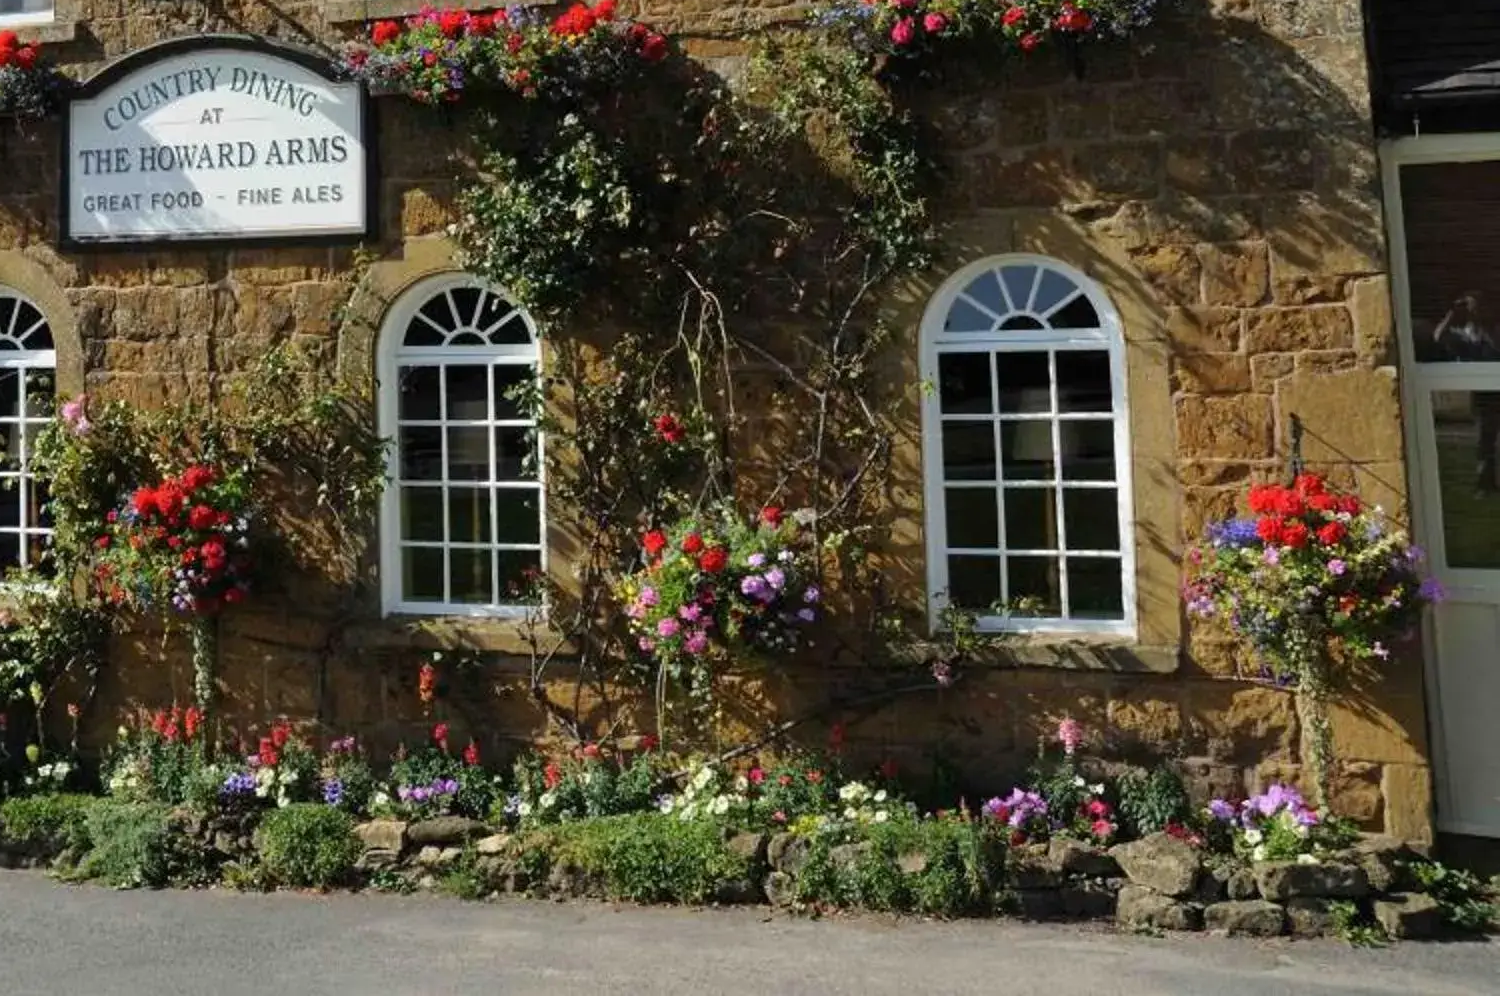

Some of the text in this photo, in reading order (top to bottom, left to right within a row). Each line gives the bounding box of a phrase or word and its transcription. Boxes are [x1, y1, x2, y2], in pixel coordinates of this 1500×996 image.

[103, 66, 318, 131] COUNTRY DINING
[199, 108, 223, 125] AT
[79, 136, 348, 175] THE HOWARD ARMS
[83, 194, 141, 213] GREAT
[151, 190, 204, 210] FOOD
[237, 188, 283, 206] FINE
[291, 184, 344, 203] ALES
